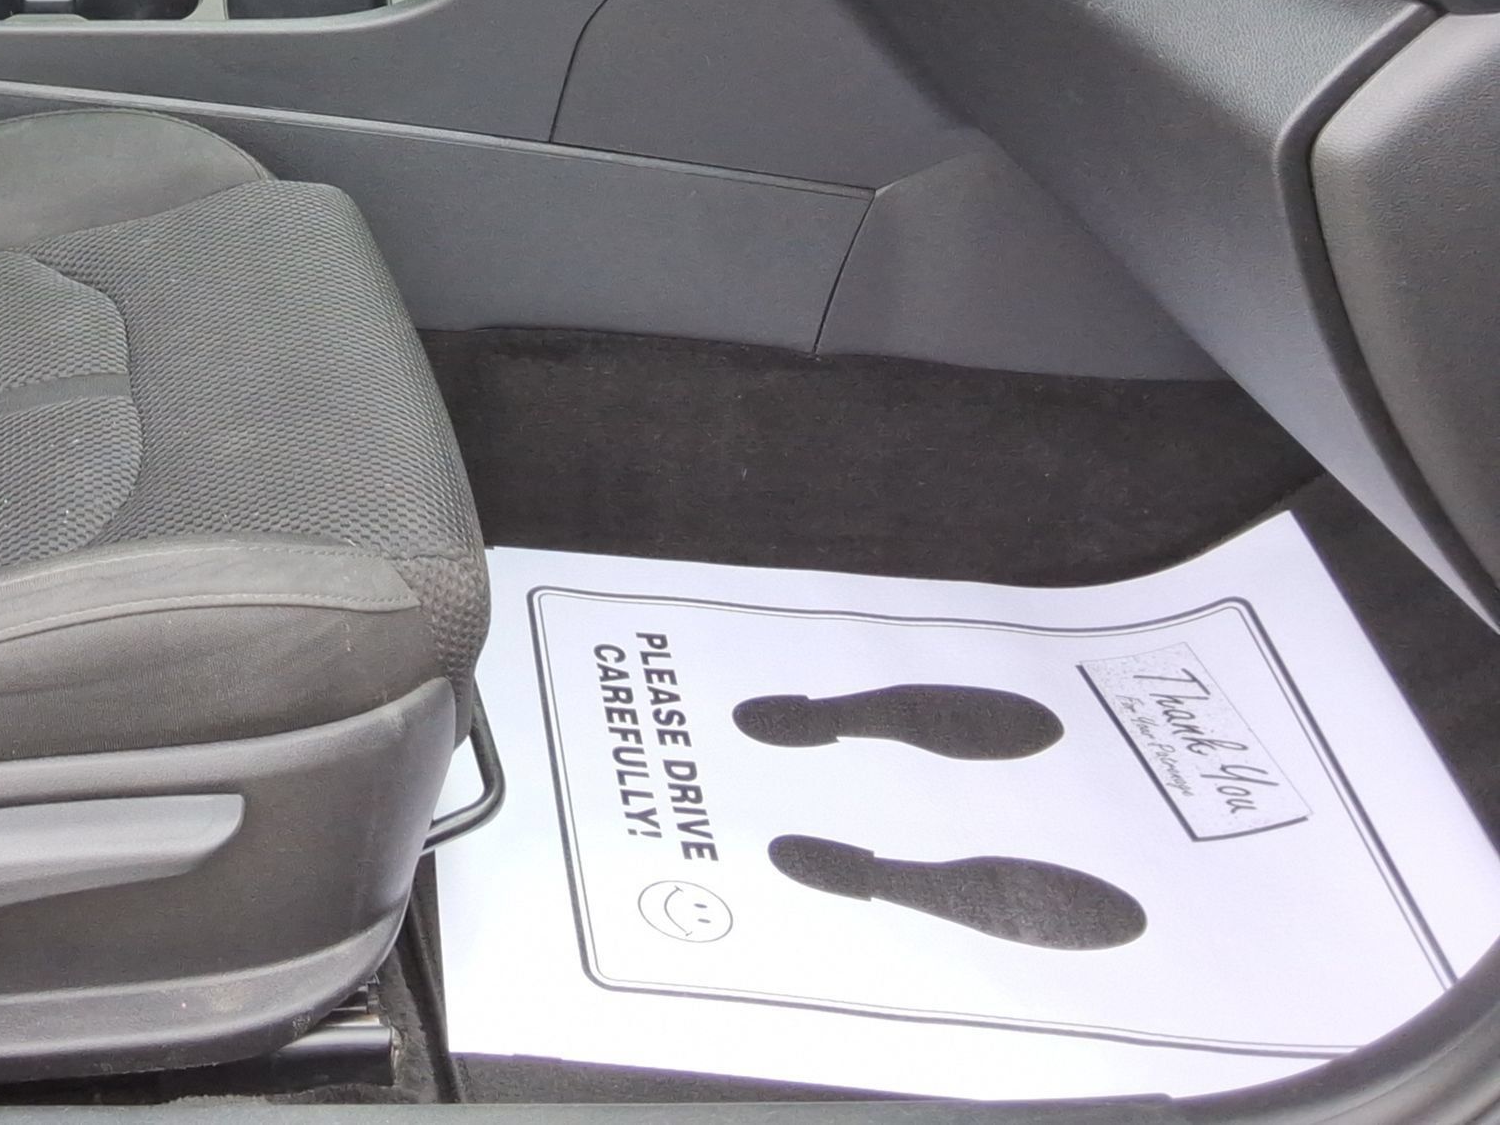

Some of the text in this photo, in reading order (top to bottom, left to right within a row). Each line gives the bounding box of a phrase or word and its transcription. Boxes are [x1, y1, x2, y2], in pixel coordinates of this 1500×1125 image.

[593, 643, 663, 839] CAREFULLY!
[636, 631, 719, 862] PLEASE DRIVE
[1133, 668, 1279, 814] Thank You
